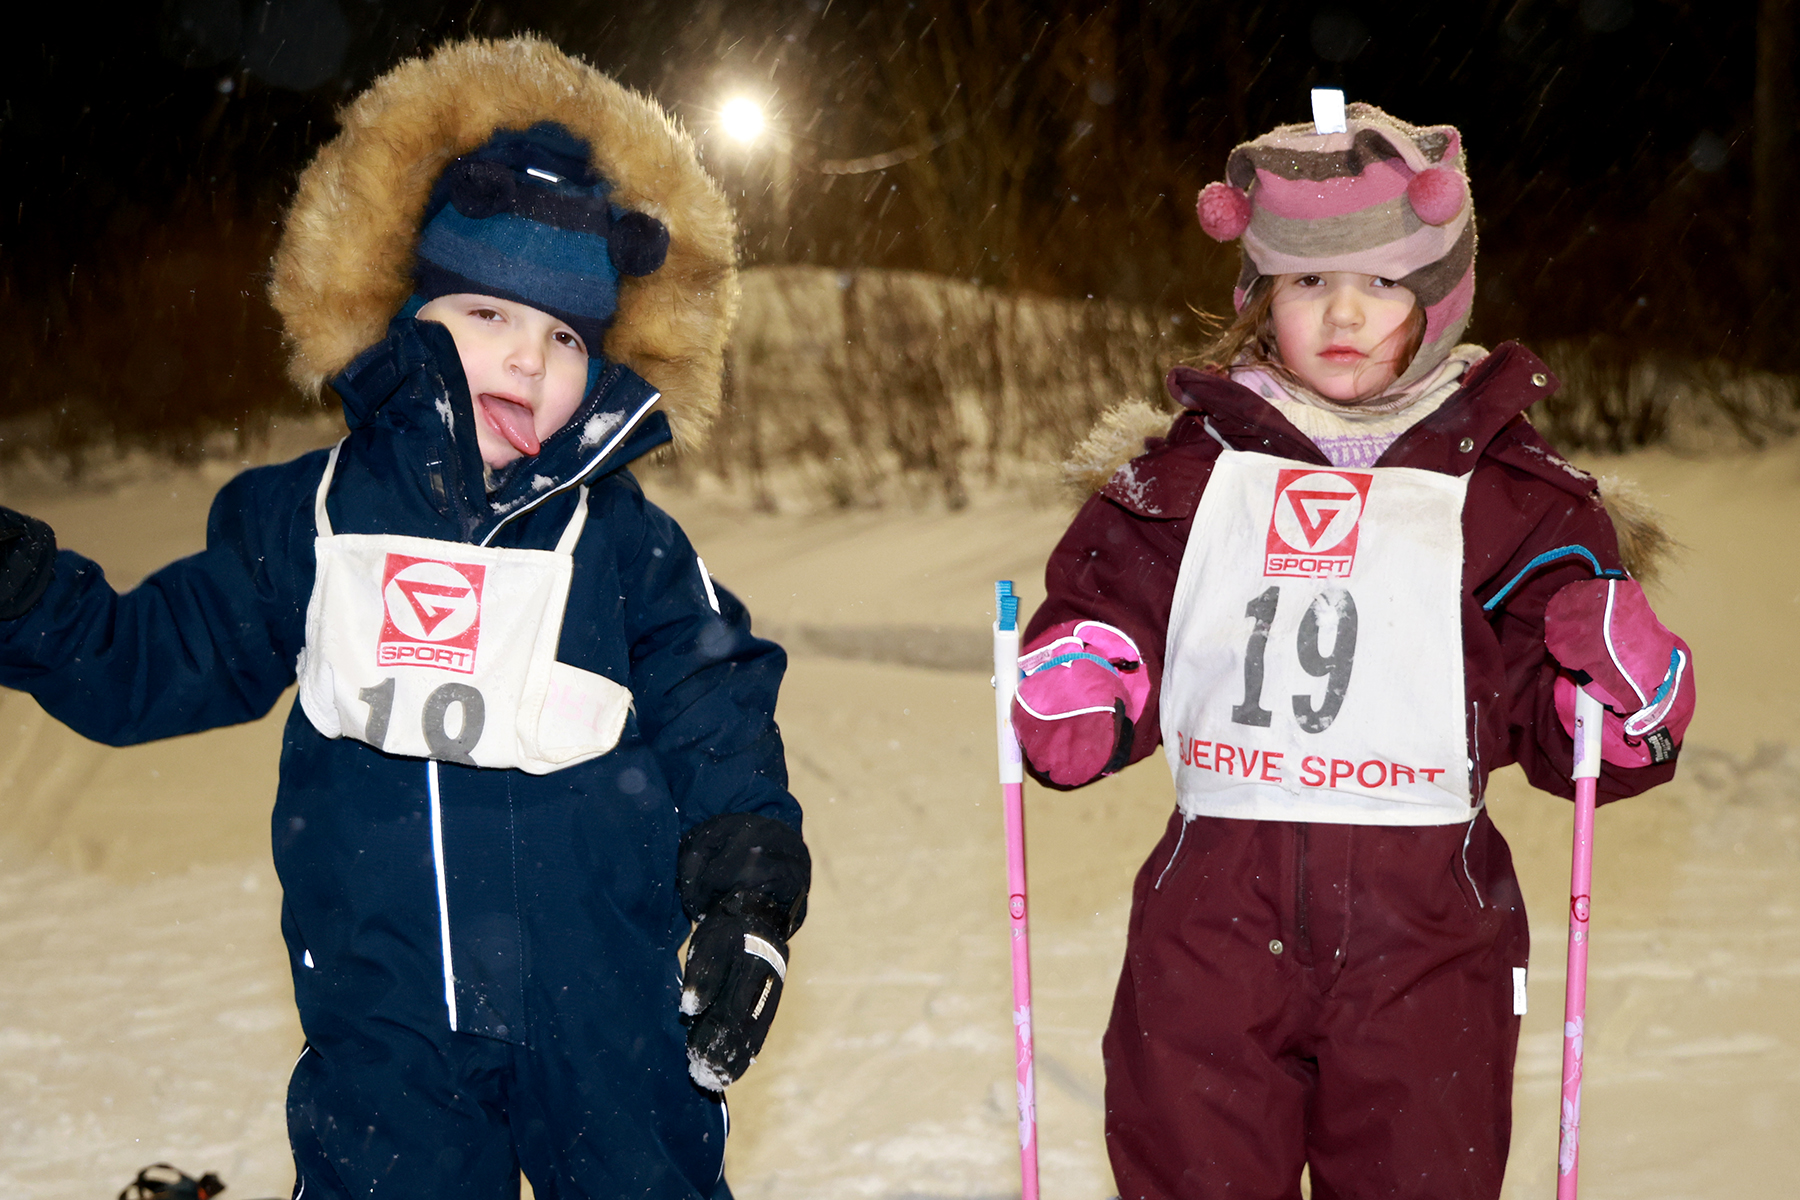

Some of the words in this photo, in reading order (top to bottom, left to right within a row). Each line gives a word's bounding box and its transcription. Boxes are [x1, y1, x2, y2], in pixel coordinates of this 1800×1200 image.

[1268, 558, 1349, 573] SPORT
[381, 646, 470, 667] SPORT
[1231, 585, 1358, 734] 19
[1299, 755, 1445, 788] SPORT
